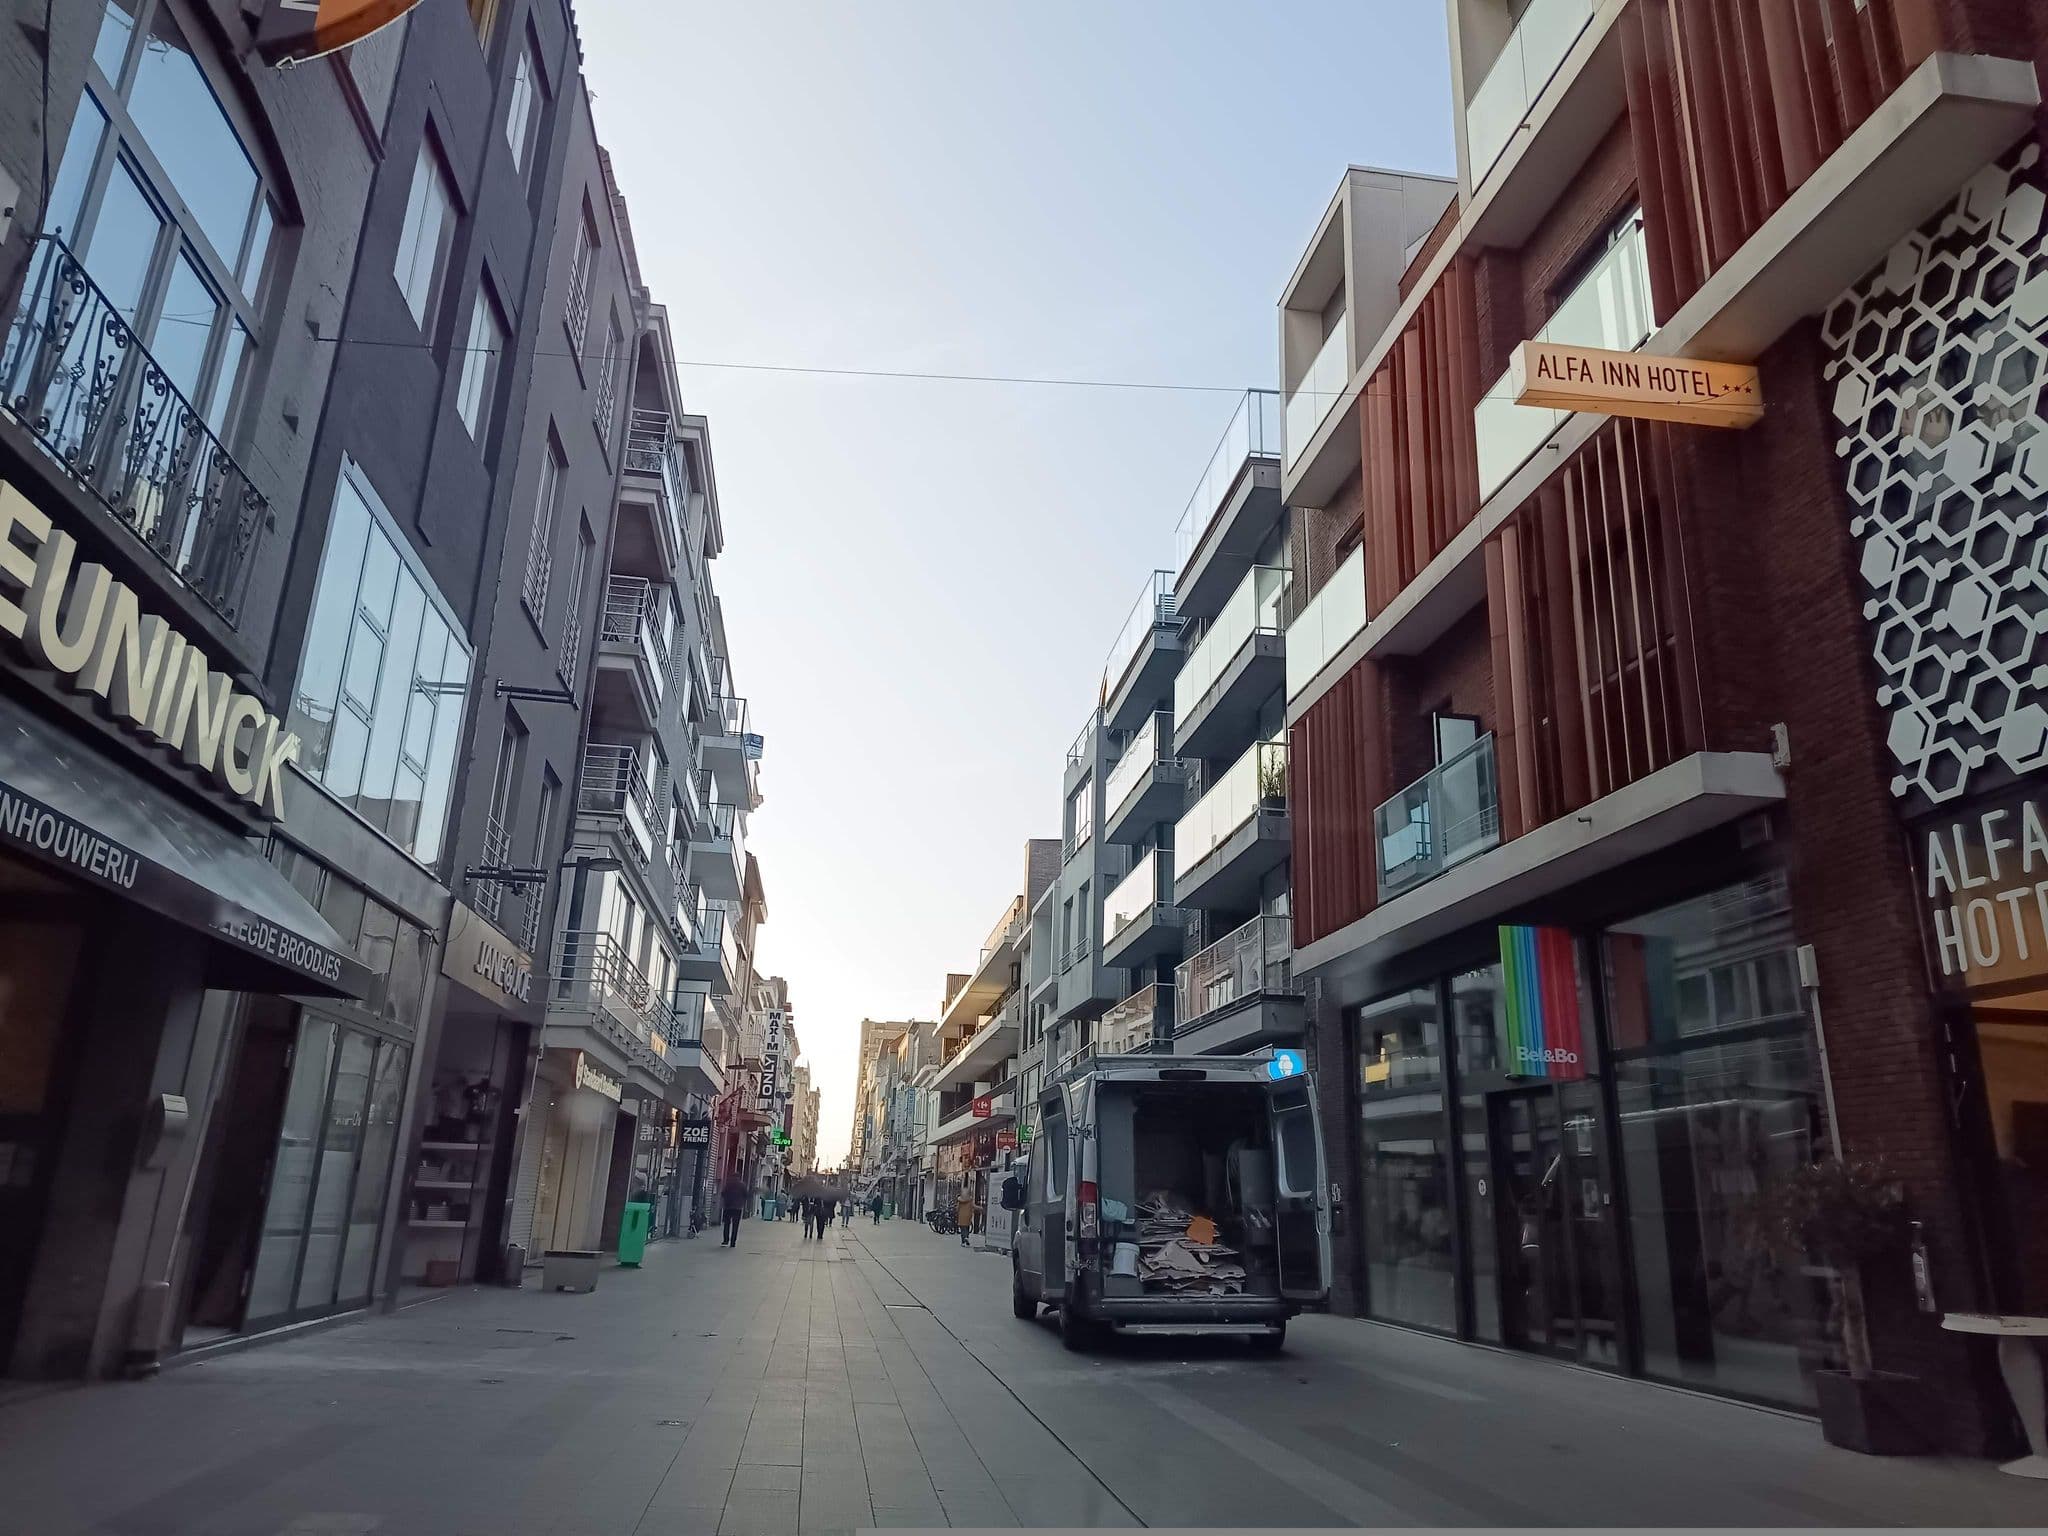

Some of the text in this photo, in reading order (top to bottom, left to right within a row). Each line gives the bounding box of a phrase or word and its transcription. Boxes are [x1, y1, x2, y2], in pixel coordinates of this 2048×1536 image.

[1537, 354, 1720, 398] ALFA INN HOTEL
[0, 789, 139, 889] NHOUWERIJ
[1927, 800, 2048, 898] ALFA
[277, 932, 341, 981] BROODJES
[767, 1012, 781, 1051] MAXIM
[762, 1056, 776, 1096] ONLY
[1516, 1046, 1578, 1064] Bel&Bo
[683, 1126, 709, 1137] ZOË
